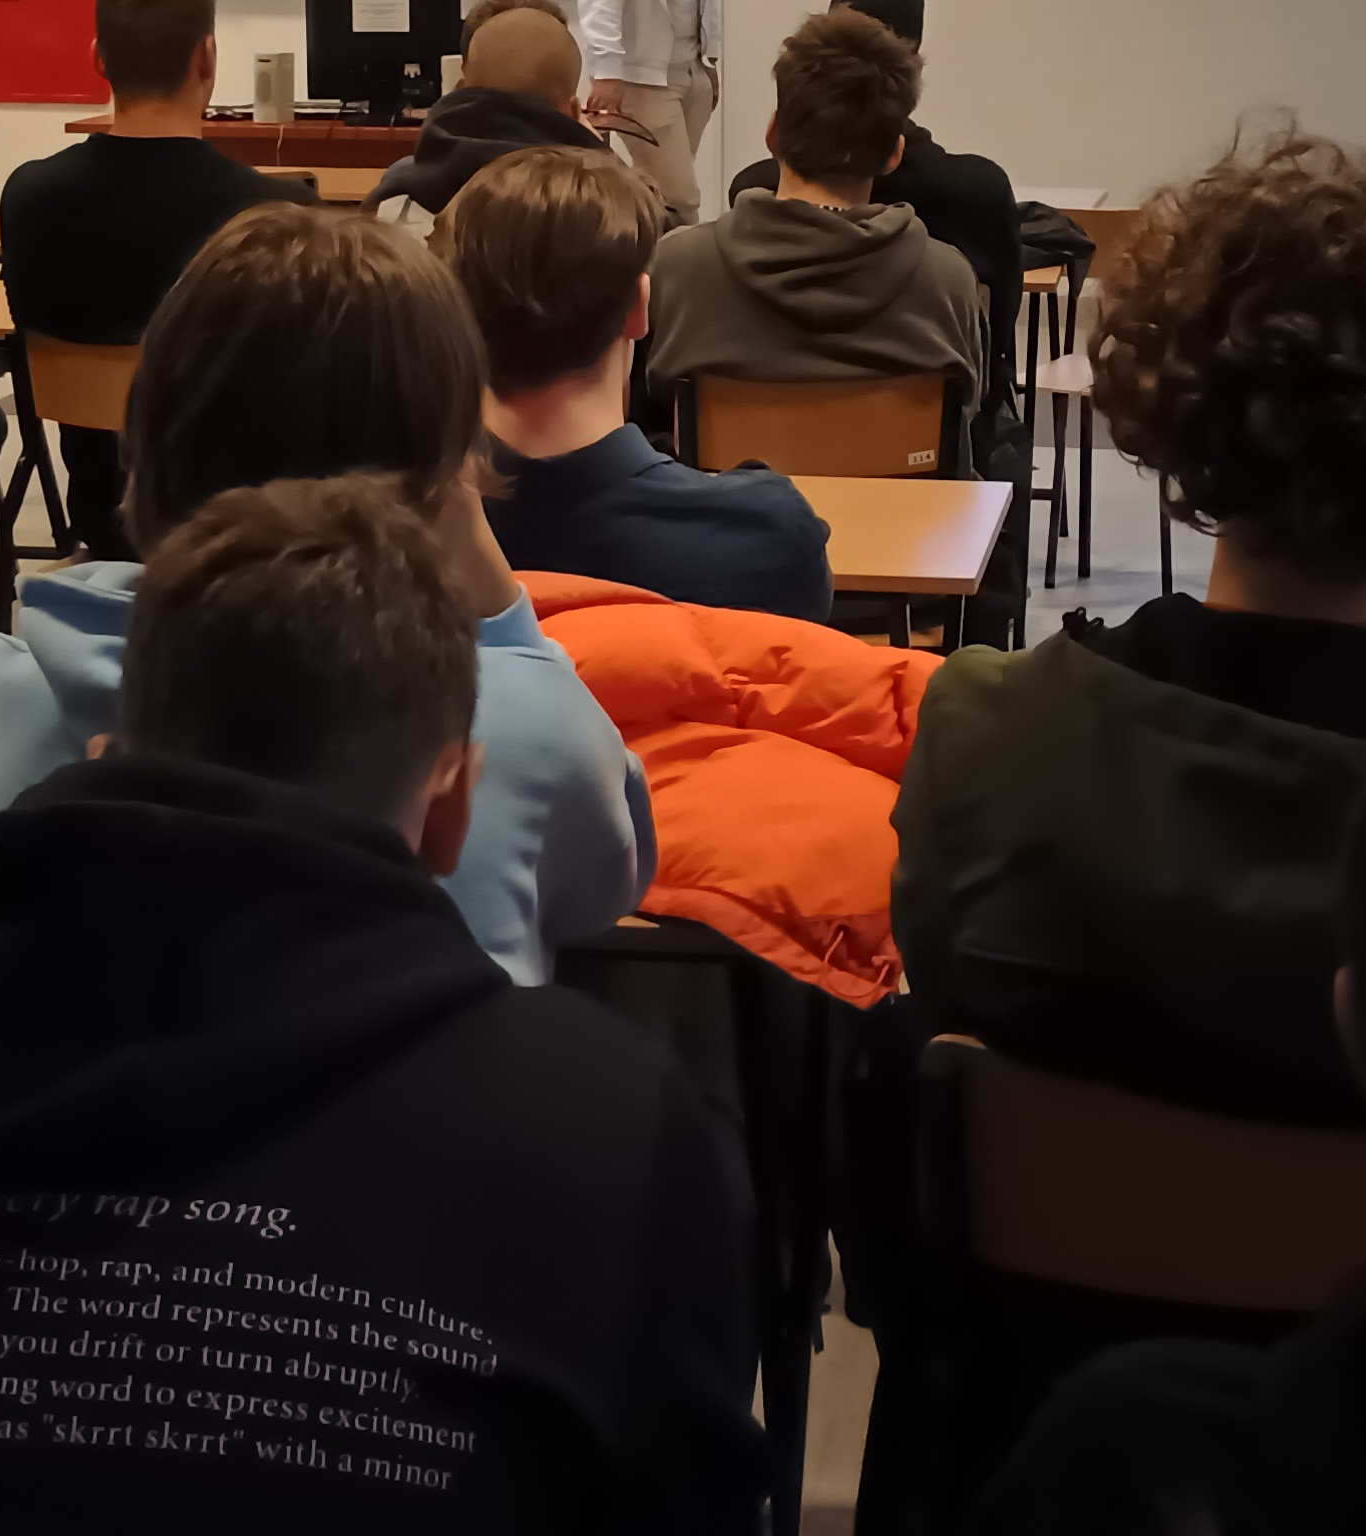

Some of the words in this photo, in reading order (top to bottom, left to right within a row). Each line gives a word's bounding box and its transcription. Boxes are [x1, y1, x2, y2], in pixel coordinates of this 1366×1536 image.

[95, 1195, 170, 1227] rap
[185, 1198, 297, 1239] song.
[7, 1287, 67, 1314] The
[79, 1295, 161, 1320] word
[171, 1303, 338, 1340] represents
[350, 1322, 397, 1351] the
[406, 1338, 497, 1377] sound
[101, 1259, 161, 1285] rap,
[173, 1263, 233, 1286] and
[244, 1274, 370, 1308] modern
[381, 1299, 494, 1345] culture.
[0, 1334, 58, 1358] you
[69, 1331, 144, 1360] drift
[156, 1344, 191, 1362] or
[201, 1345, 273, 1373] turn
[284, 1352, 419, 1403] abruptly.
[42, 1414, 132, 1446] "skrrt
[145, 1421, 244, 1455] skrrt"
[256, 1437, 326, 1469] with
[338, 1454, 352, 1472] a
[364, 1454, 451, 1490] minor
[50, 1376, 132, 1402] word
[144, 1381, 175, 1405] to
[187, 1389, 308, 1420] express
[319, 1408, 476, 1453] excitement
